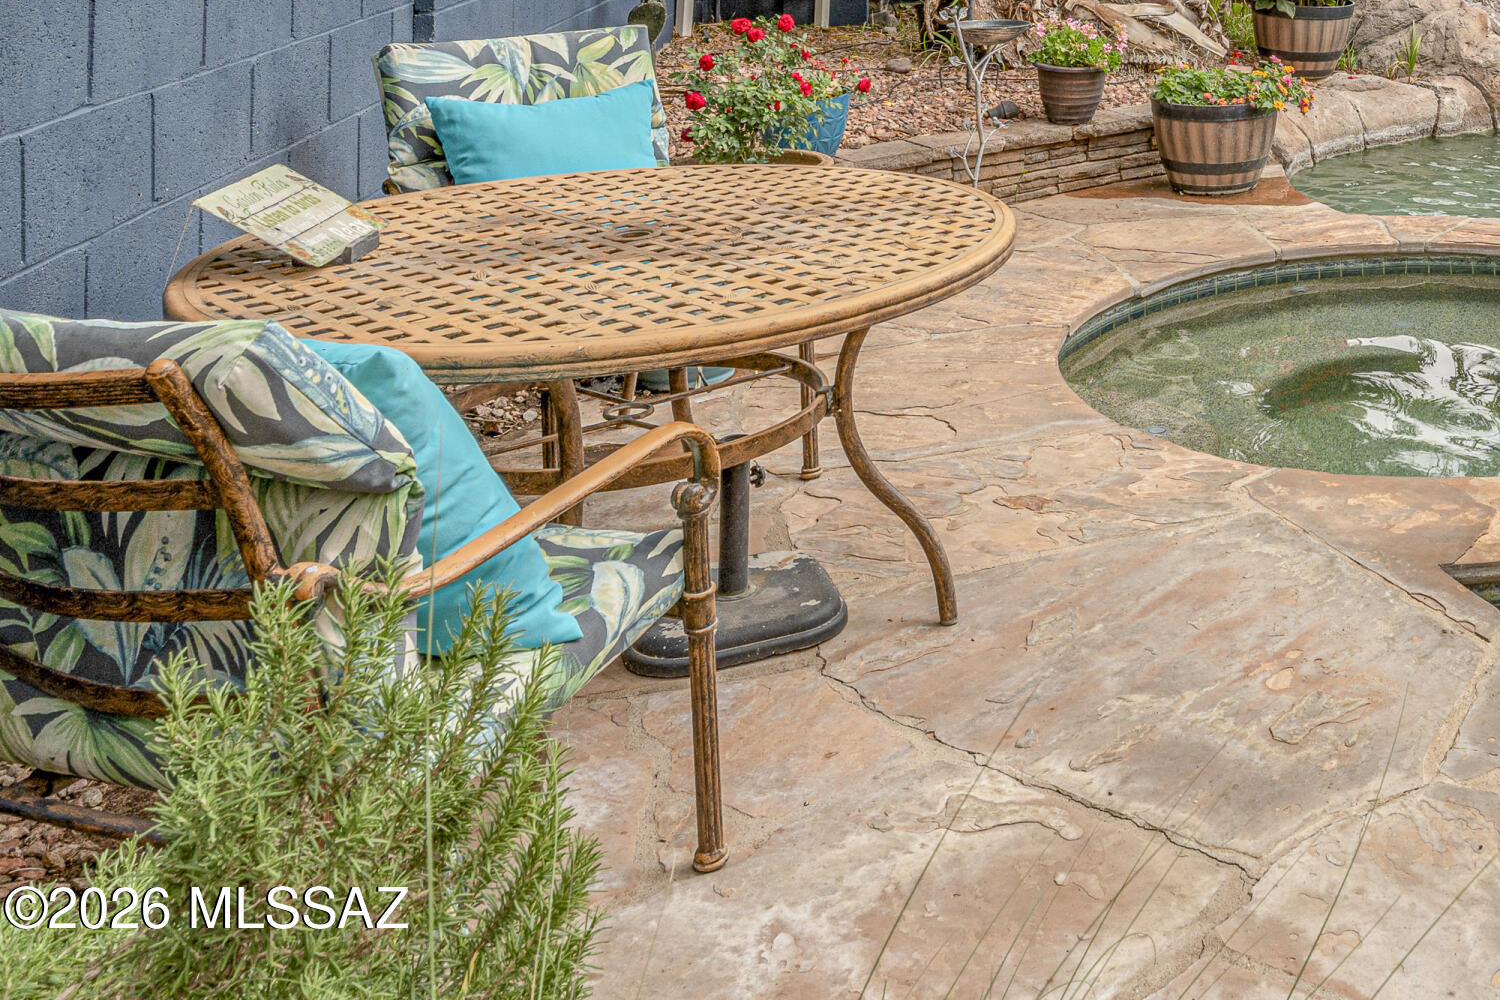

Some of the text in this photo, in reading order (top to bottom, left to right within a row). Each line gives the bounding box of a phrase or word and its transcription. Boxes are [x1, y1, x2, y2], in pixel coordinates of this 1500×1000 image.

[278, 203, 301, 215] to
[287, 192, 321, 210] birds
[251, 209, 291, 228] Listen
